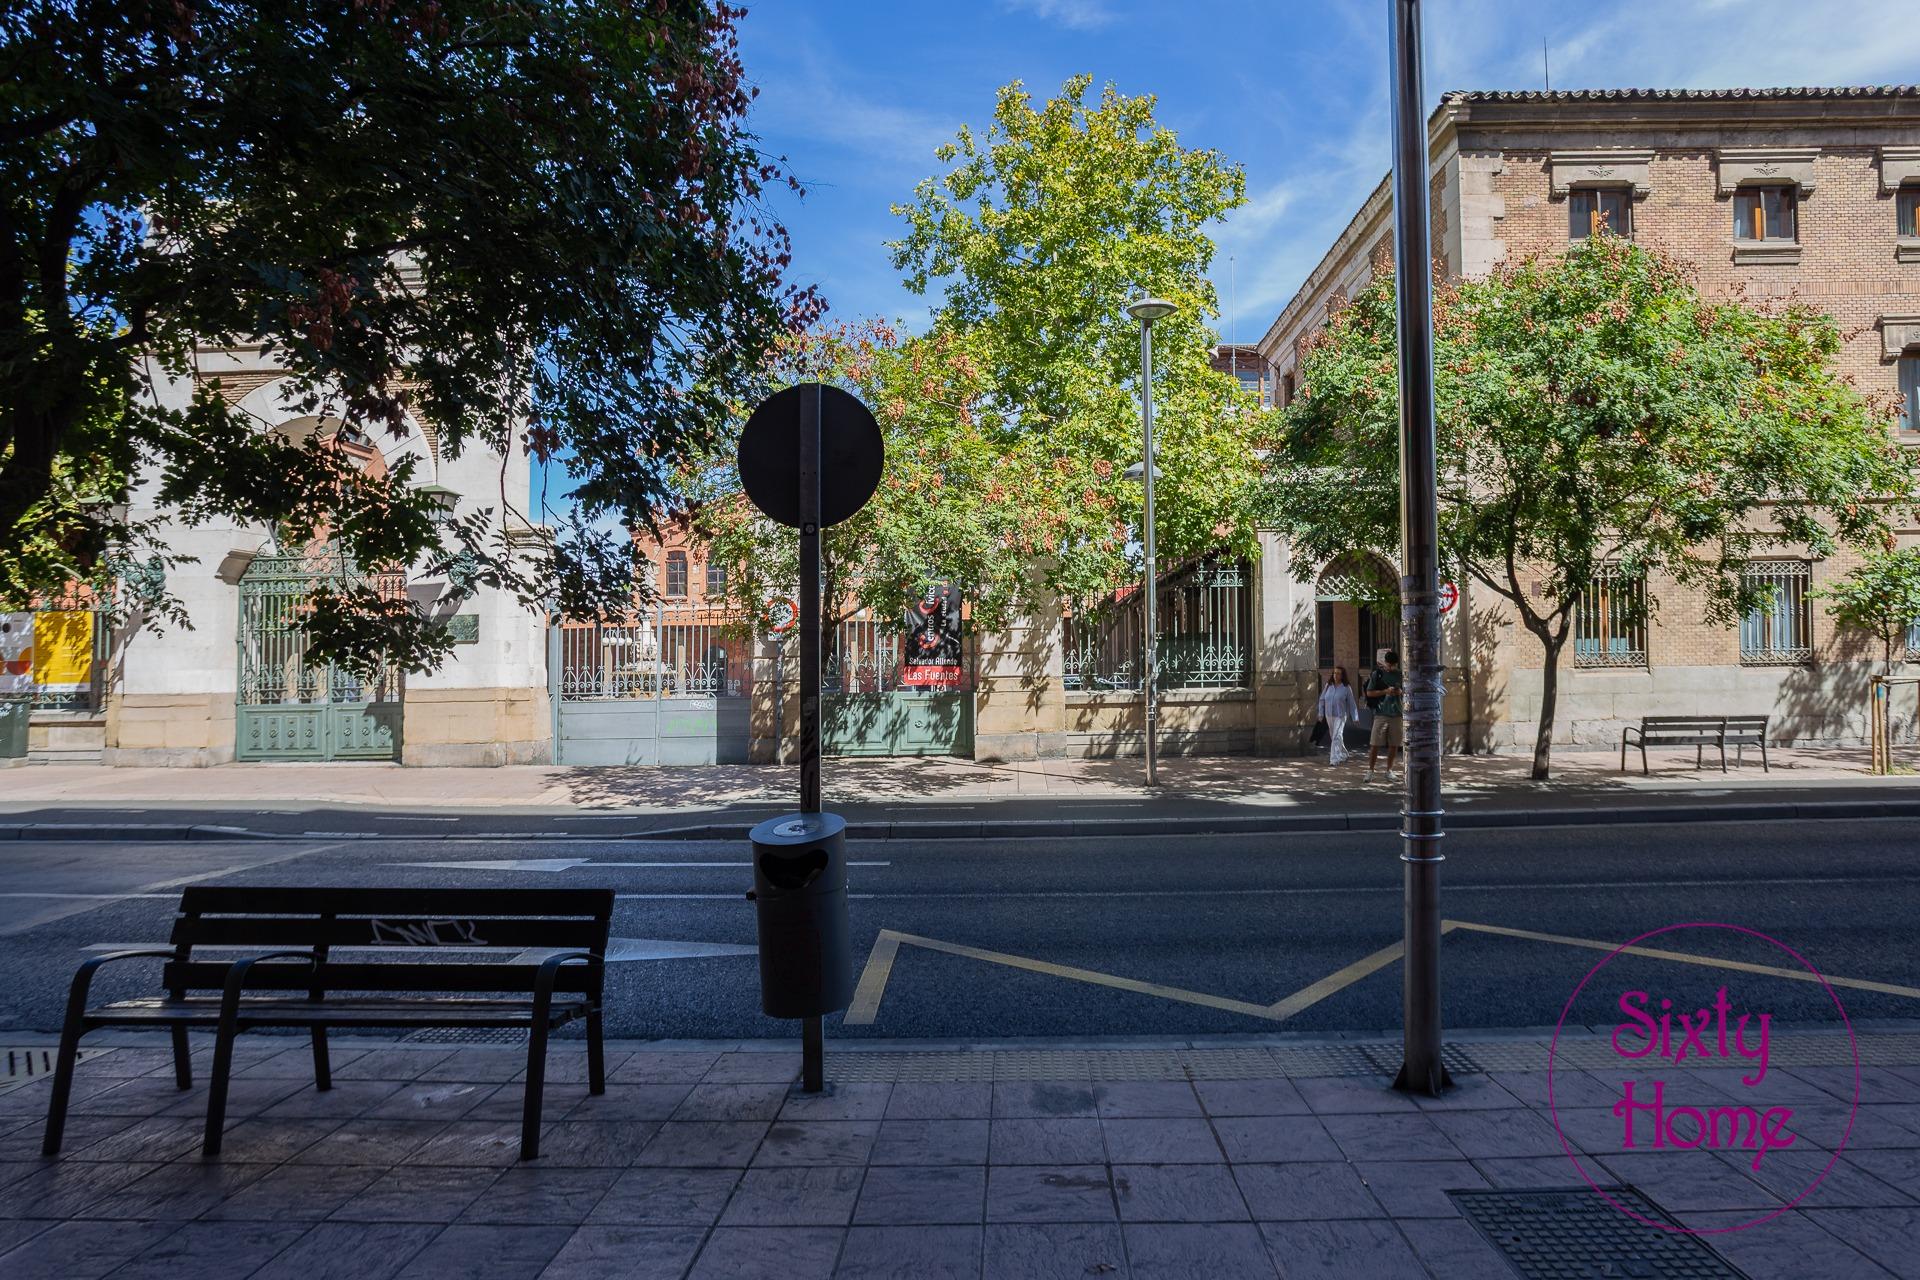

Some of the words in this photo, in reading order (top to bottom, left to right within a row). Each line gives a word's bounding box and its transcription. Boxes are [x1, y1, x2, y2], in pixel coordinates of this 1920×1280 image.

[918, 583, 940, 614] Cívico
[918, 614, 941, 650] Centros
[909, 657, 934, 665] Salvador
[935, 656, 958, 665] Allende
[907, 668, 923, 681] Las
[924, 669, 959, 681] Fuentes
